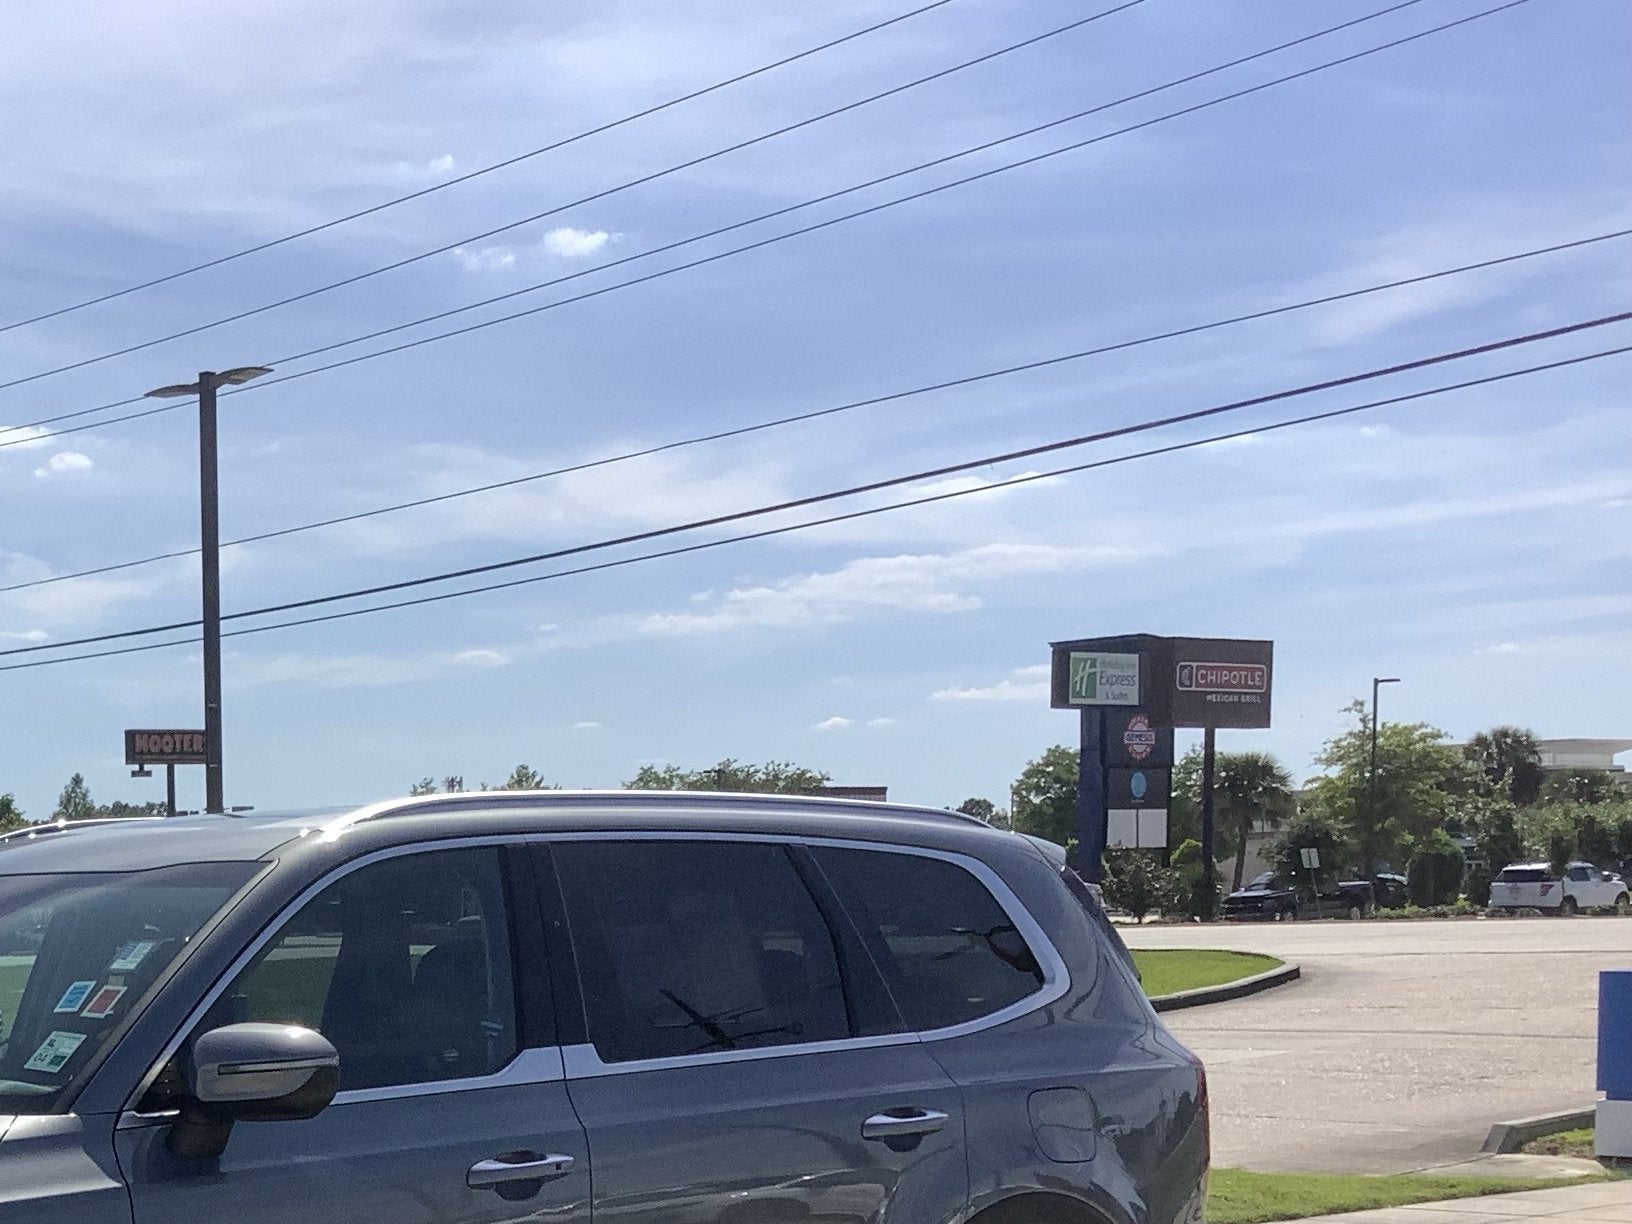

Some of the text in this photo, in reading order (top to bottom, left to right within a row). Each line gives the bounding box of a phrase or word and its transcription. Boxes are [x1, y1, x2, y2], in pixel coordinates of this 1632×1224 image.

[1099, 671, 1136, 688] Express
[1197, 670, 1263, 685] CHIPOTLE
[1207, 694, 1239, 702] MEXICAN
[134, 734, 206, 753] HOOTER
